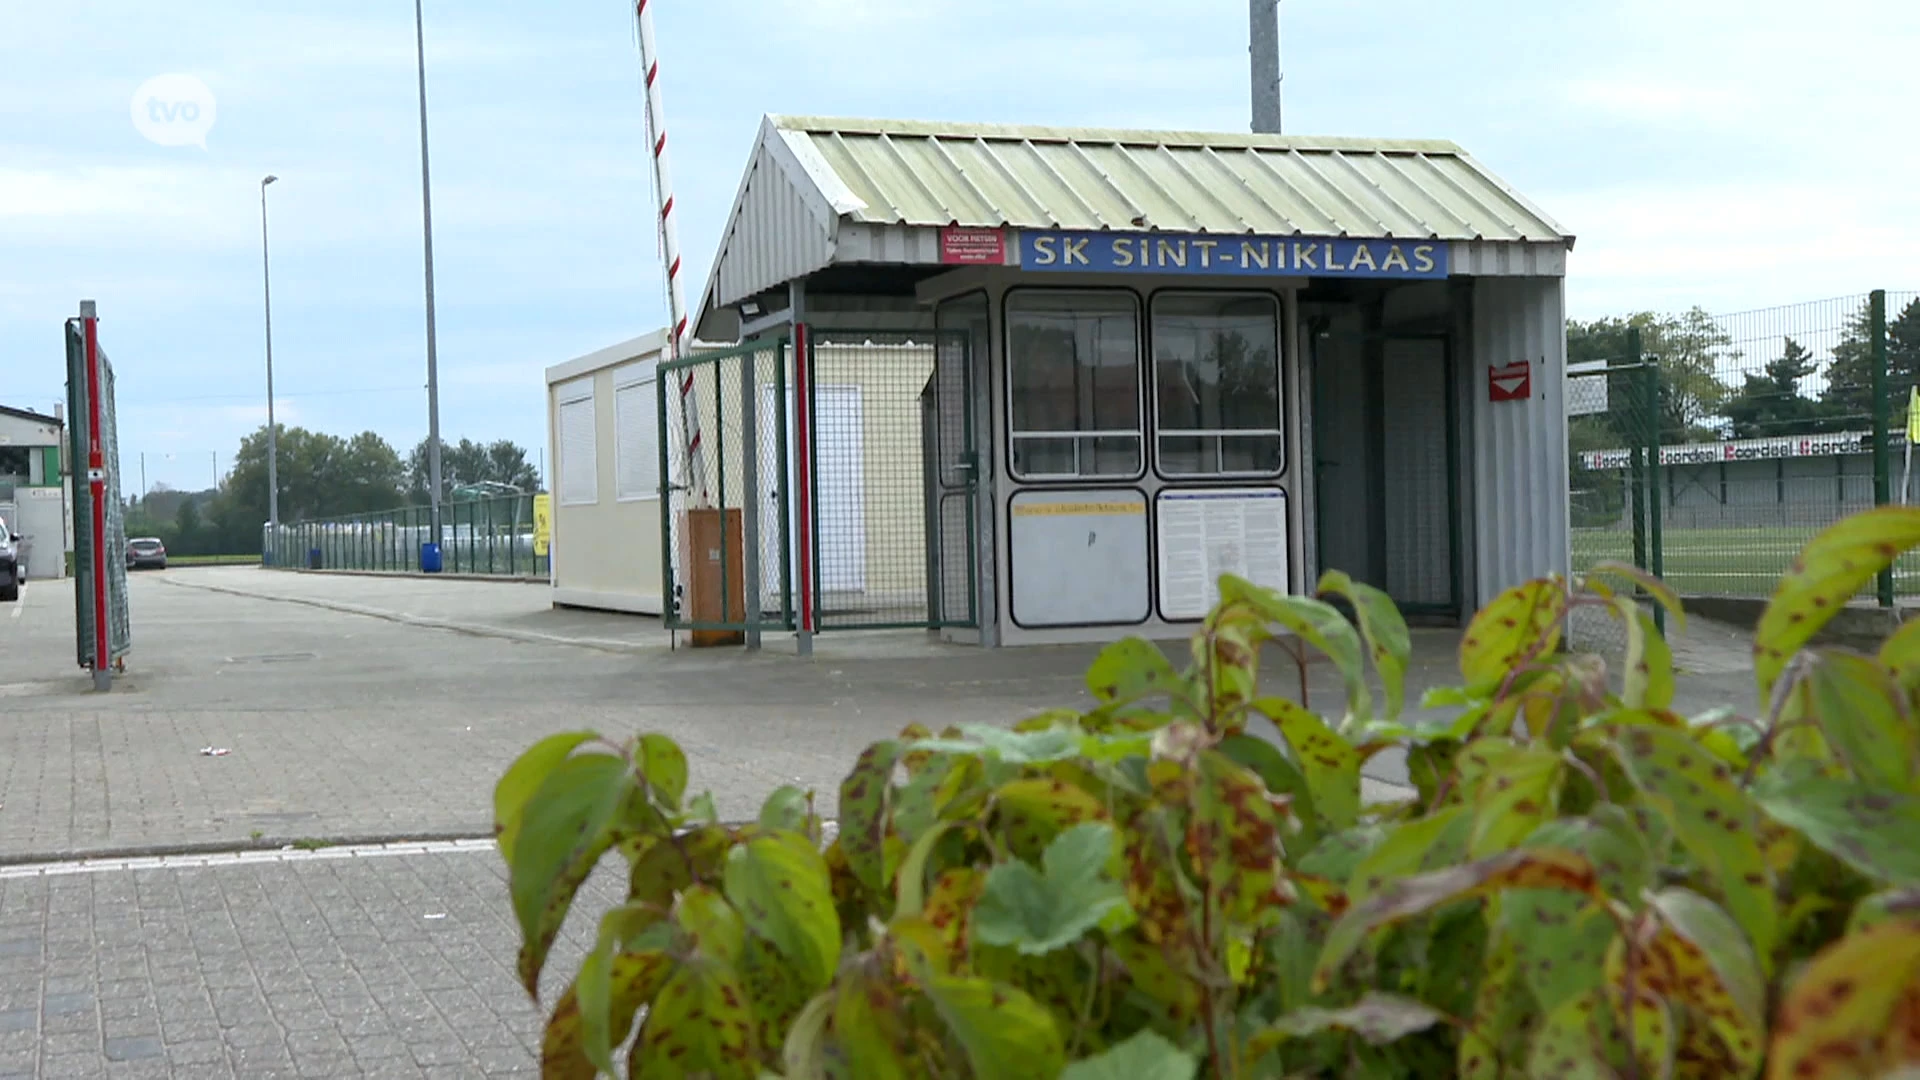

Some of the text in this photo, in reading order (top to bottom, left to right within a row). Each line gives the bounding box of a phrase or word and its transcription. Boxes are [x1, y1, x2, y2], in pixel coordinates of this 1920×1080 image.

[1033, 236, 1434, 272] SK SINT-NIKLAAS
[1735, 440, 1793, 459] cordeel
[1812, 437, 1861, 453] corde
